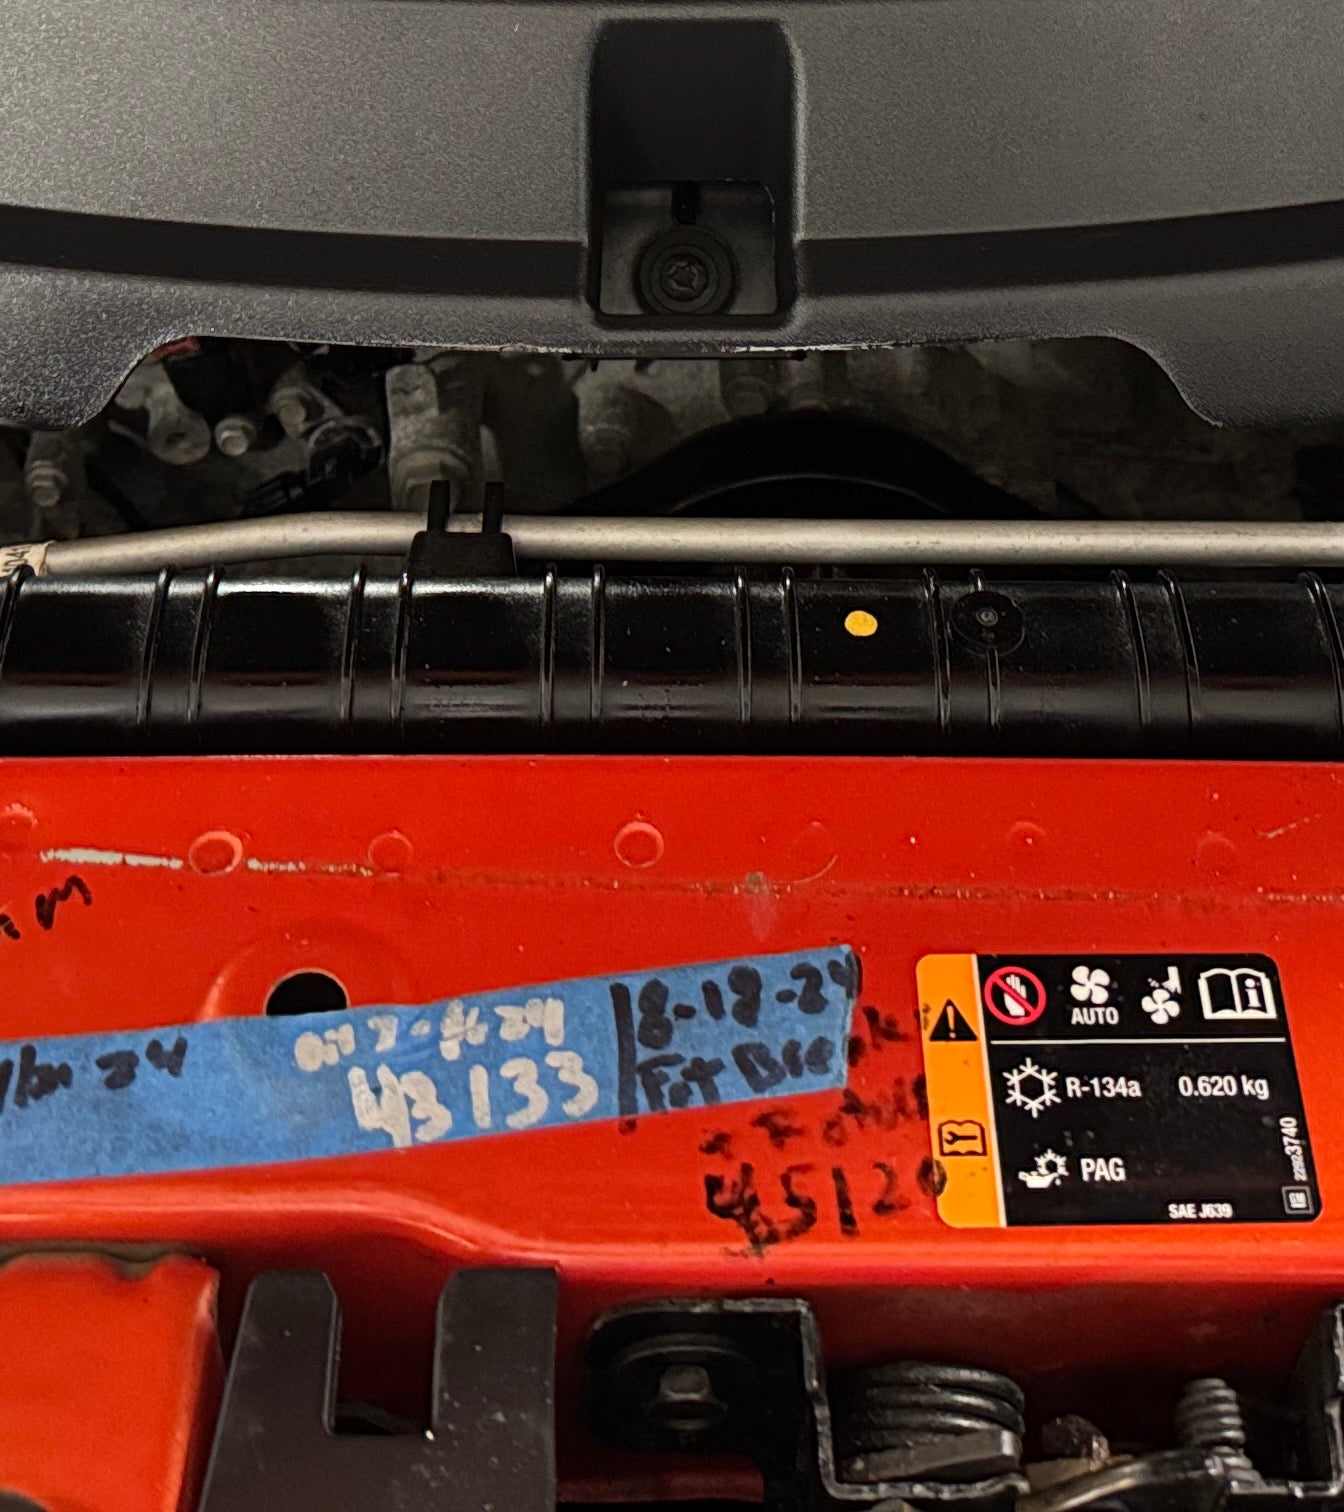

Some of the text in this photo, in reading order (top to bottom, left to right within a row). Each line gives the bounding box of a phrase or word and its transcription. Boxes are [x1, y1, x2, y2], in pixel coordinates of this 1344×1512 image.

[1071, 1006, 1119, 1026] AUTO
[1066, 1073, 1270, 1101] R-134a 0.620 kg
[1080, 1157, 1127, 1182] PAG
[1168, 1202, 1234, 1221] SAE J639
